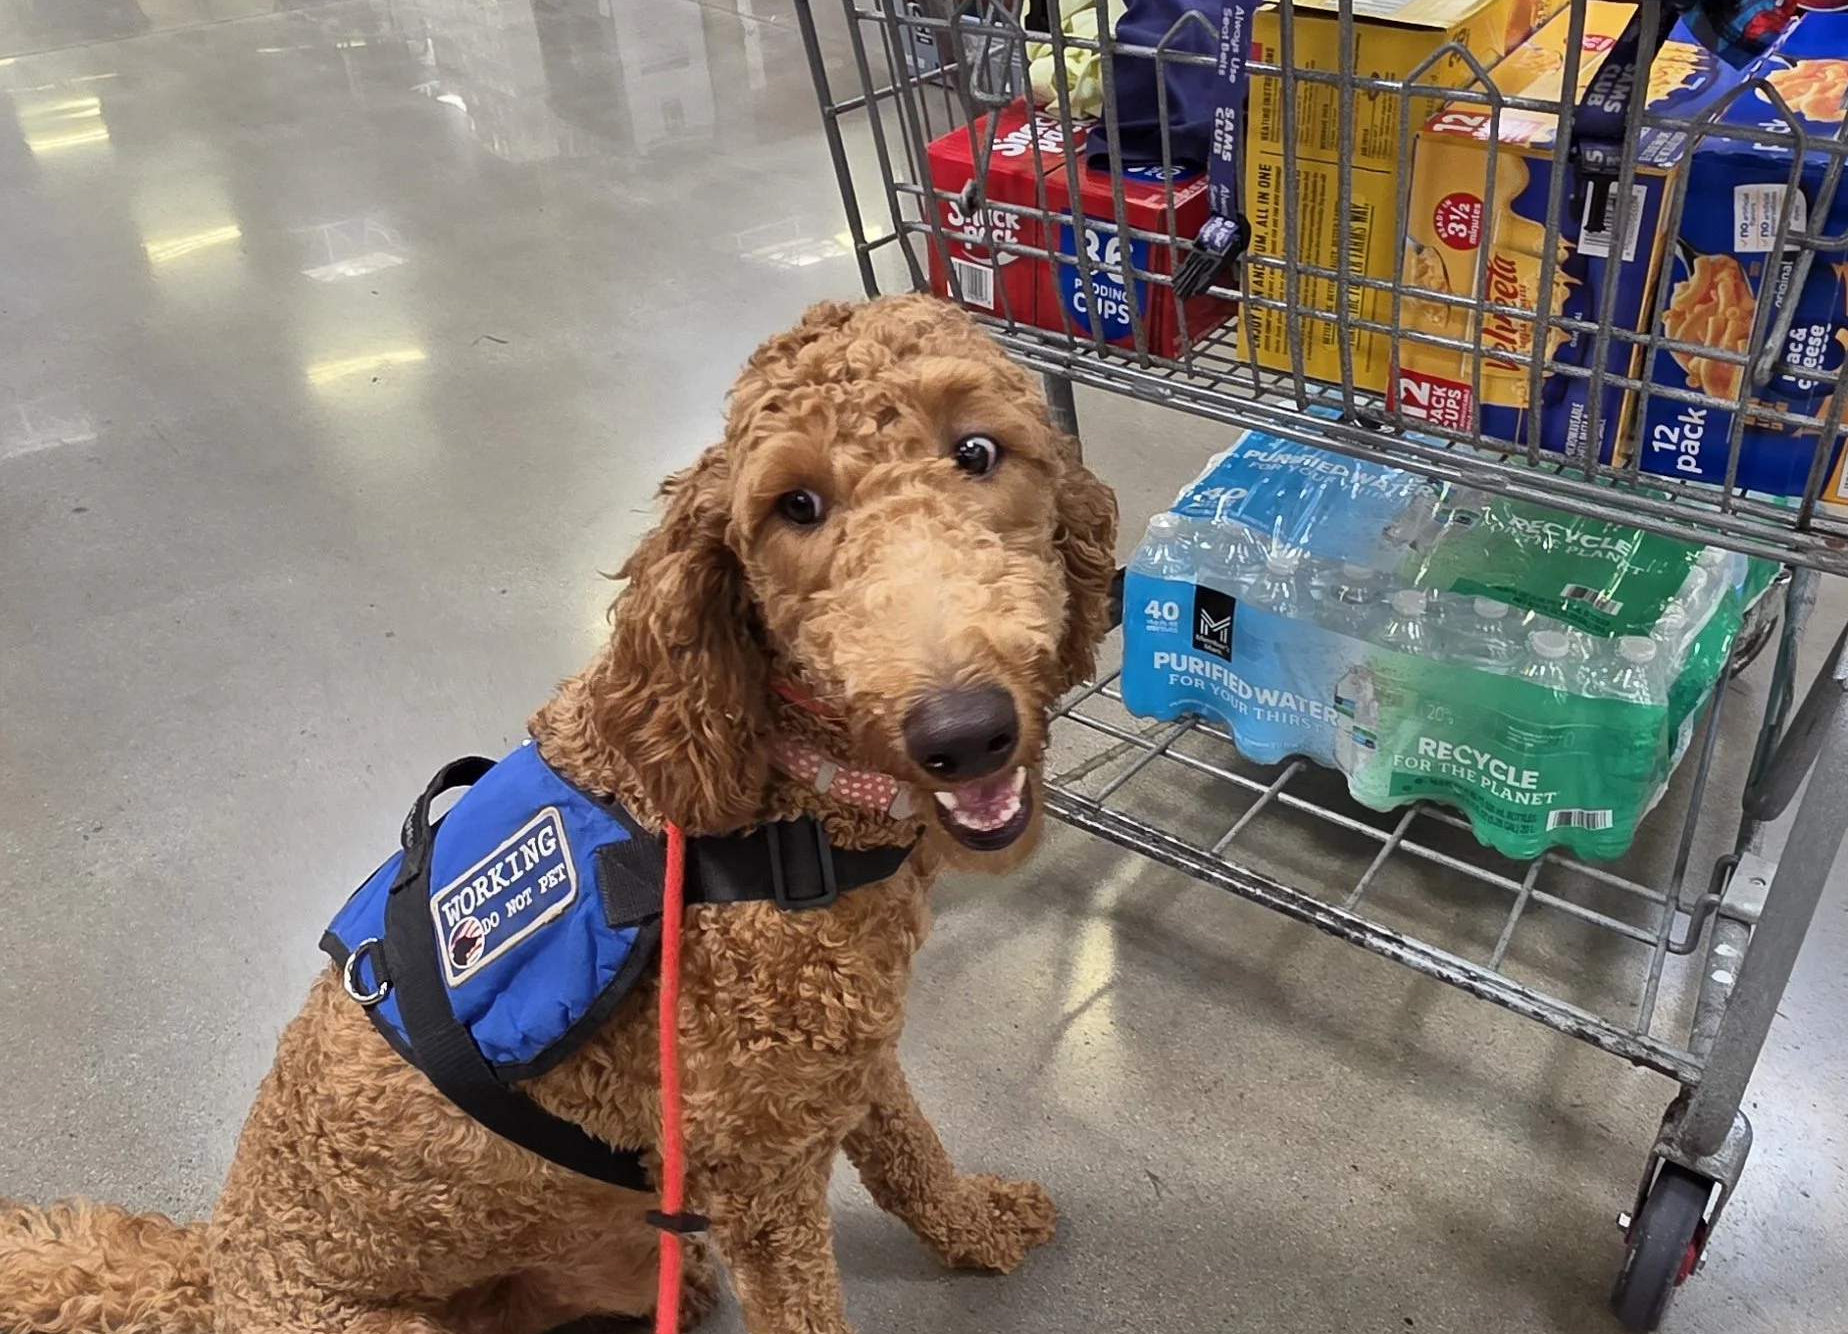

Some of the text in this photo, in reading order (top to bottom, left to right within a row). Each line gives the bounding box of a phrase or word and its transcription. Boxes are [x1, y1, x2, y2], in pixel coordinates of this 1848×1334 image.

[1218, 8, 1233, 76] Seat Belts
[1229, 5, 1245, 83] Always Use
[1587, 63, 1621, 107] CLUB
[1213, 107, 1224, 155] CLUB
[1222, 107, 1235, 162] SAMS
[1433, 114, 1485, 132] 12
[1258, 190, 1270, 202] IN
[1259, 163, 1271, 188] ONE
[1257, 203, 1269, 227] ALL
[1437, 211, 1449, 239] READY
[1469, 203, 1482, 245] minutes
[1739, 192, 1750, 238] no artificial
[1760, 191, 1770, 238] no artificial
[1769, 190, 1778, 237] preservatives
[1774, 259, 1794, 308] original
[1789, 327, 1807, 342] &
[1798, 324, 1826, 390] ceese
[1400, 378, 1430, 419] 12
[1651, 423, 1681, 454] 12
[1676, 407, 1709, 474] pack
[1243, 449, 1349, 478] PURIFIED
[1250, 461, 1282, 473] FOR
[1509, 516, 1634, 557] RECYCLE
[1565, 544, 1645, 576] PLANET
[1144, 600, 1180, 621] 40
[1195, 633, 1231, 653] Member's
[1154, 651, 1339, 727] PURIFIED WATER
[1168, 673, 1325, 734] FOR YOUR THIRST
[1392, 754, 1432, 772] FOR
[1438, 762, 1477, 784] THE
[1480, 776, 1561, 806] PLANET
[1418, 736, 1540, 789] RECYCLE
[441, 825, 557, 928] WORKING
[481, 862, 568, 937] DO NOT PET
